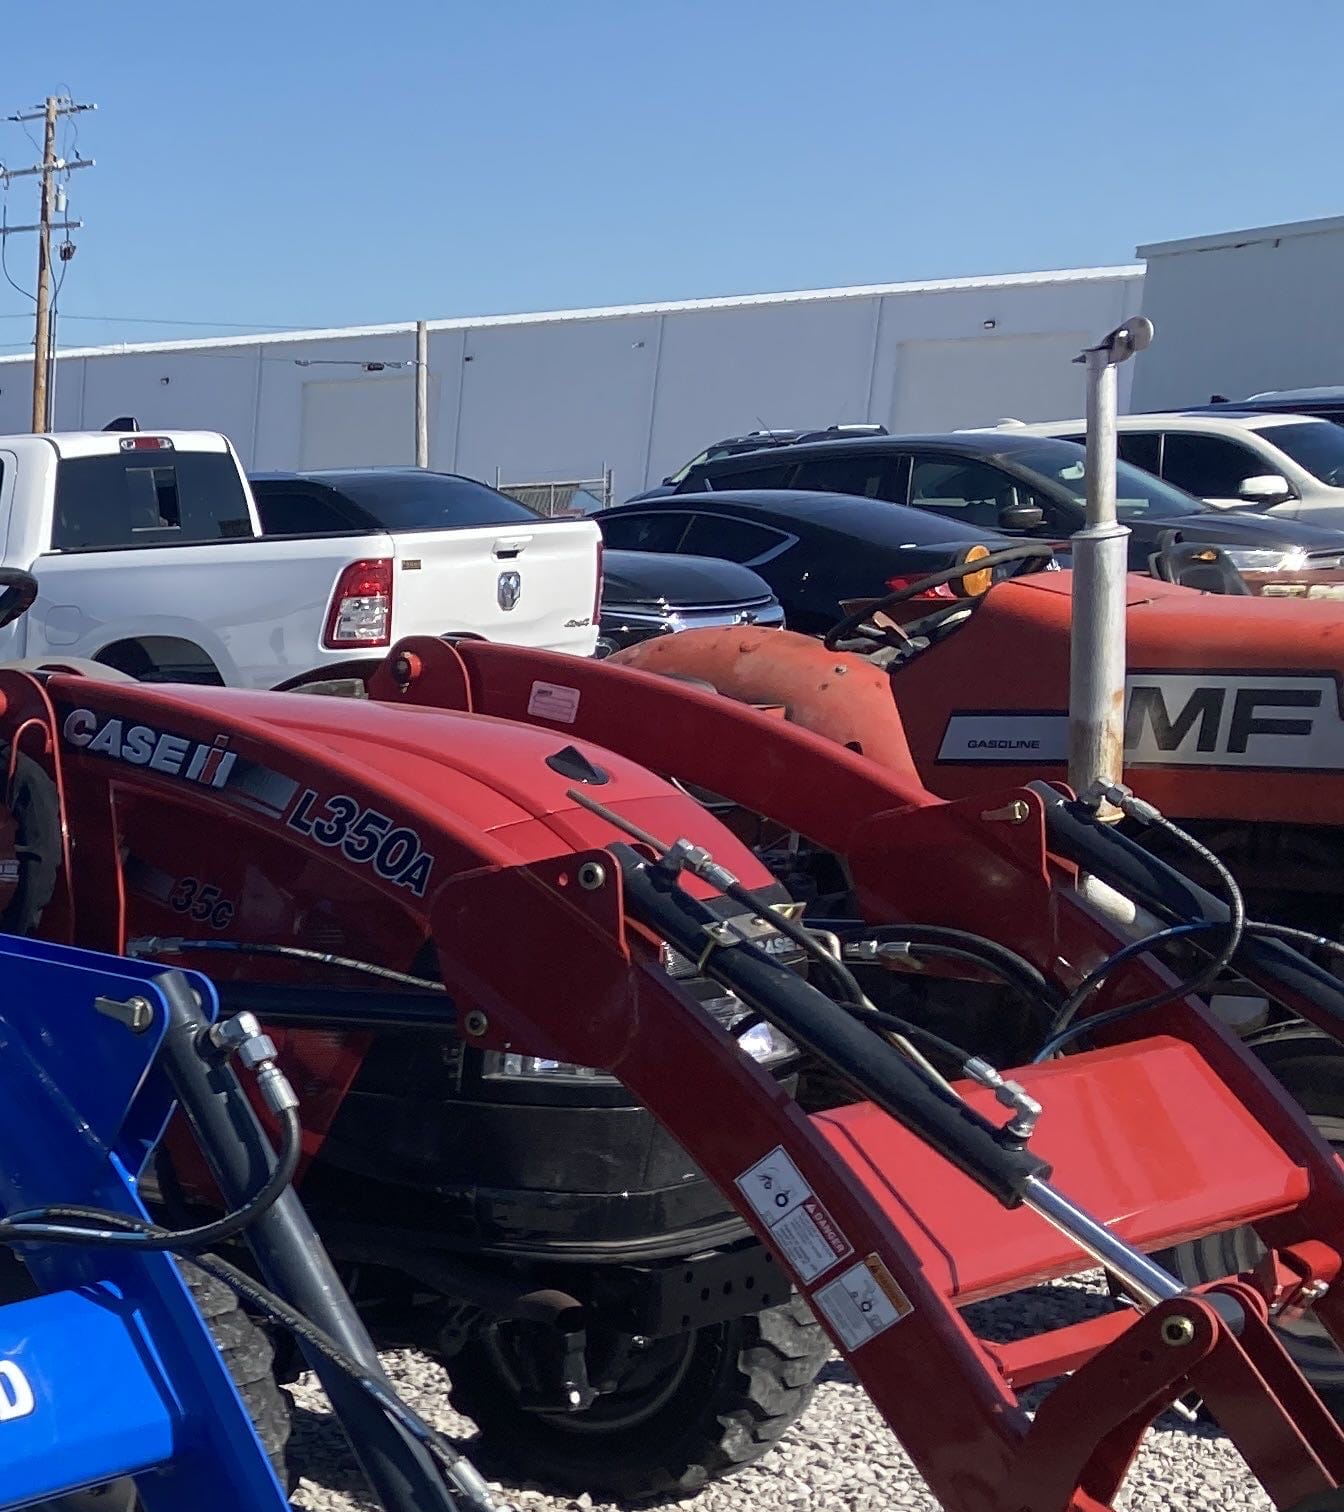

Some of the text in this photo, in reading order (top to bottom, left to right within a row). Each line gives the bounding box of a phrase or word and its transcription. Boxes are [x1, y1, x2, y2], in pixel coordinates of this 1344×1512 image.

[62, 706, 191, 776] CASE
[966, 737, 1041, 750] GASOLINE
[1125, 686, 1323, 754] MF
[285, 787, 435, 899] L350A
[170, 876, 236, 930] 35C
[814, 1211, 845, 1253] DANGER
